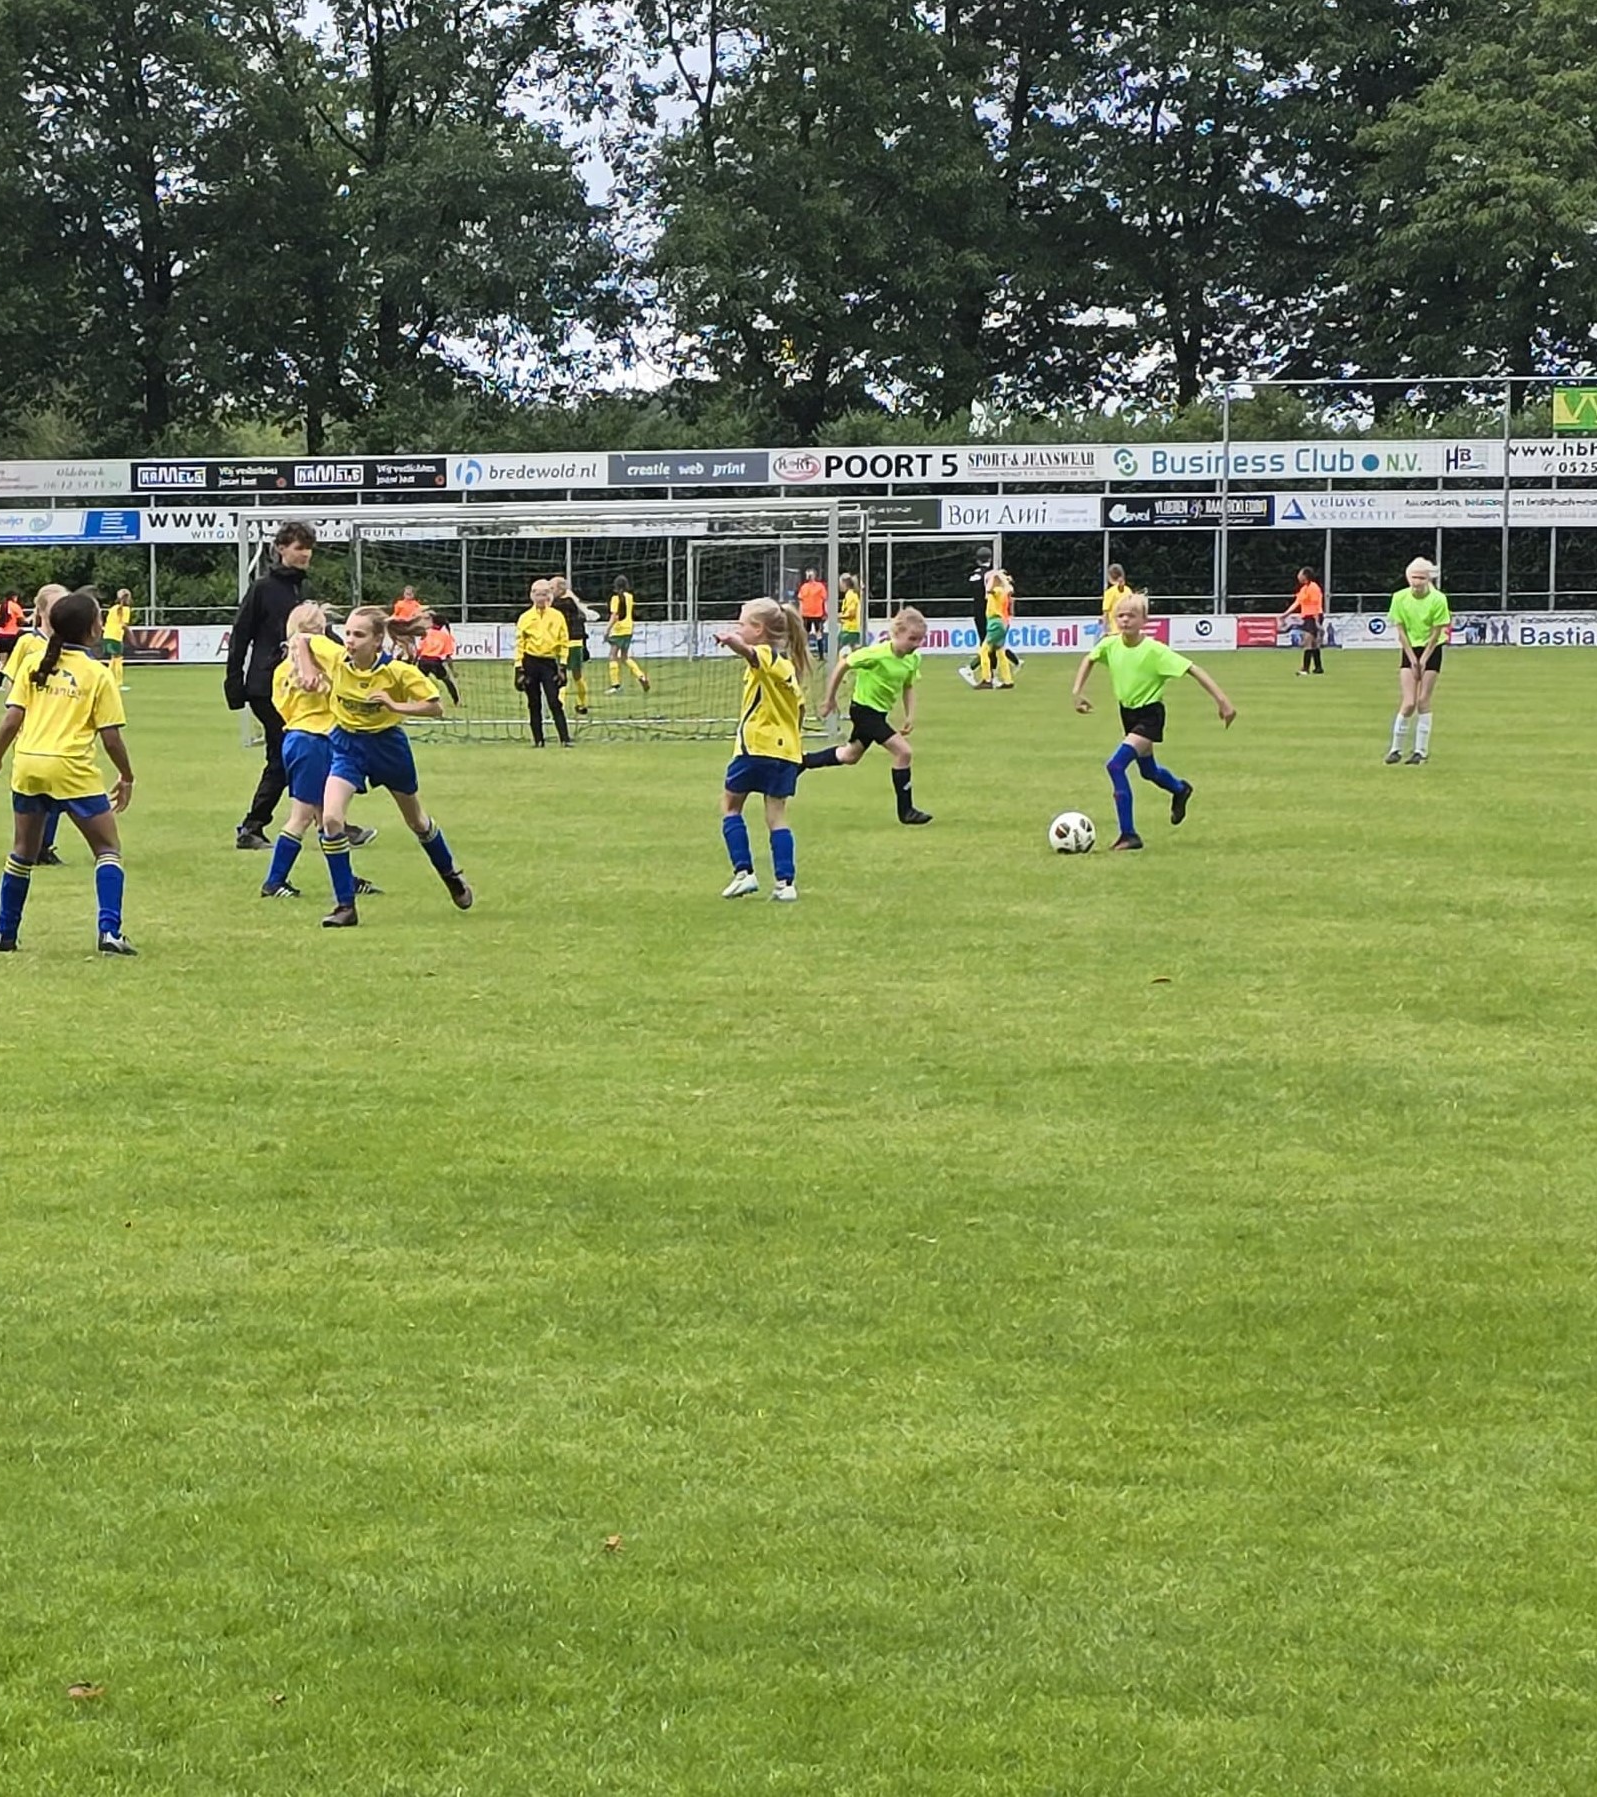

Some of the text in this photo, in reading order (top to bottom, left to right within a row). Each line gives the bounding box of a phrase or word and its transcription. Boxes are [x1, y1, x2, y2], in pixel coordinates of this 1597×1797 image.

[490, 462, 597, 479] bredewold.nl
[678, 461, 704, 475] web
[713, 462, 746, 477] print
[825, 453, 933, 478] POORT
[941, 453, 958, 477] 5
[1152, 446, 1422, 476] Business Club N.V.
[948, 504, 990, 526] Bon
[997, 501, 1048, 525] Ami
